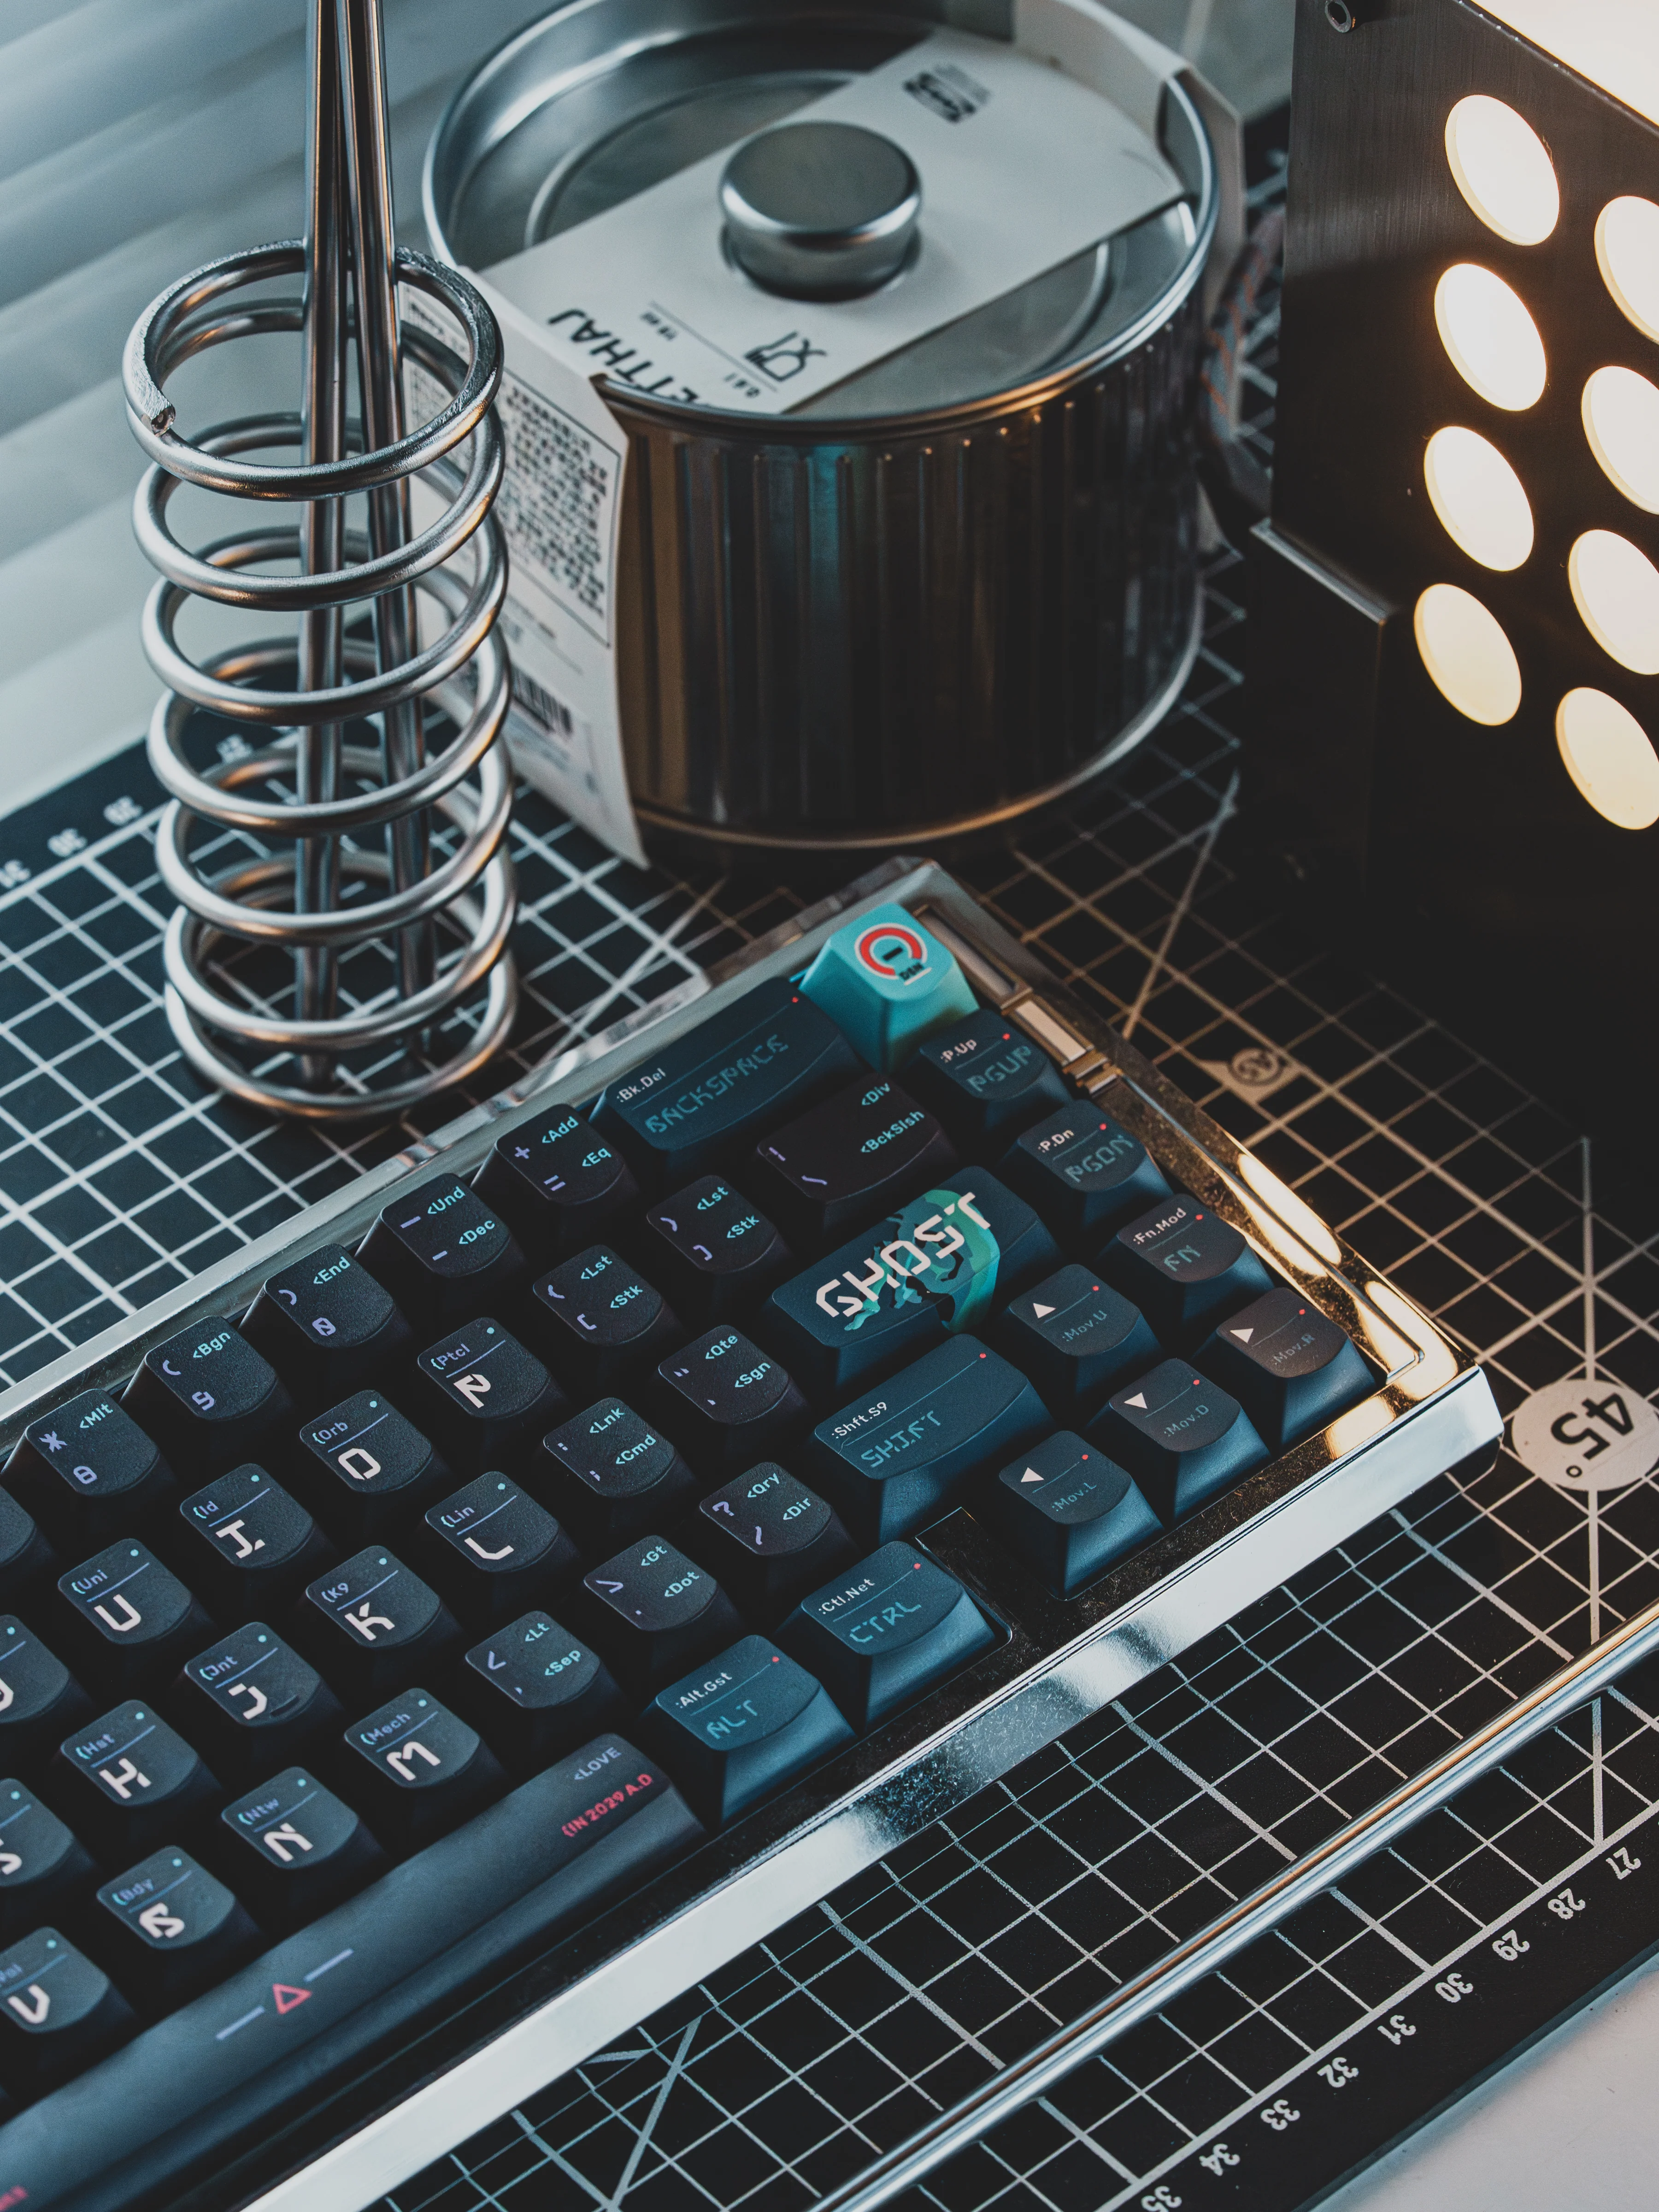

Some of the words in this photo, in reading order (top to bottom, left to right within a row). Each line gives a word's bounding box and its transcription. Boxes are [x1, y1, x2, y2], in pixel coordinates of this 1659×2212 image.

[548, 309, 700, 404] ETTHAJ
[645, 1034, 788, 1134] BACKSPACE
[967, 1045, 1032, 1092] PGUP
[542, 1116, 579, 1144] <Add
[1064, 1135, 1134, 1182] PGDN
[427, 1186, 465, 1214] <Und
[459, 1220, 495, 1245] <Dec
[313, 1256, 351, 1285] <End
[816, 1192, 991, 1318] GHOST
[1164, 1244, 1201, 1272] FN
[193, 1332, 231, 1359] <Bgn
[453, 1373, 491, 1409] P
[860, 1410, 941, 1468] SHIFT
[464, 1536, 515, 1560] L
[94, 1594, 141, 1632] U
[344, 1601, 395, 1641] K
[849, 1601, 922, 1643] CTRL
[228, 1683, 268, 1720] J
[706, 1700, 759, 1740] ALT
[98, 1757, 152, 1799] H
[386, 1741, 441, 1782] M
[263, 1822, 314, 1863] N
[1605, 1847, 1641, 1880] 27
[1547, 1888, 1586, 1920] 28
[1492, 1929, 1530, 1961] 29
[7, 1983, 51, 2025] V
[1435, 1972, 1474, 2003] 30
[1377, 2014, 1417, 2045] 31
[1317, 2056, 1359, 2088] 32
[1260, 2099, 1301, 2130] 33
[1199, 2143, 1241, 2177] 34
[1141, 2185, 1182, 2212] 35
